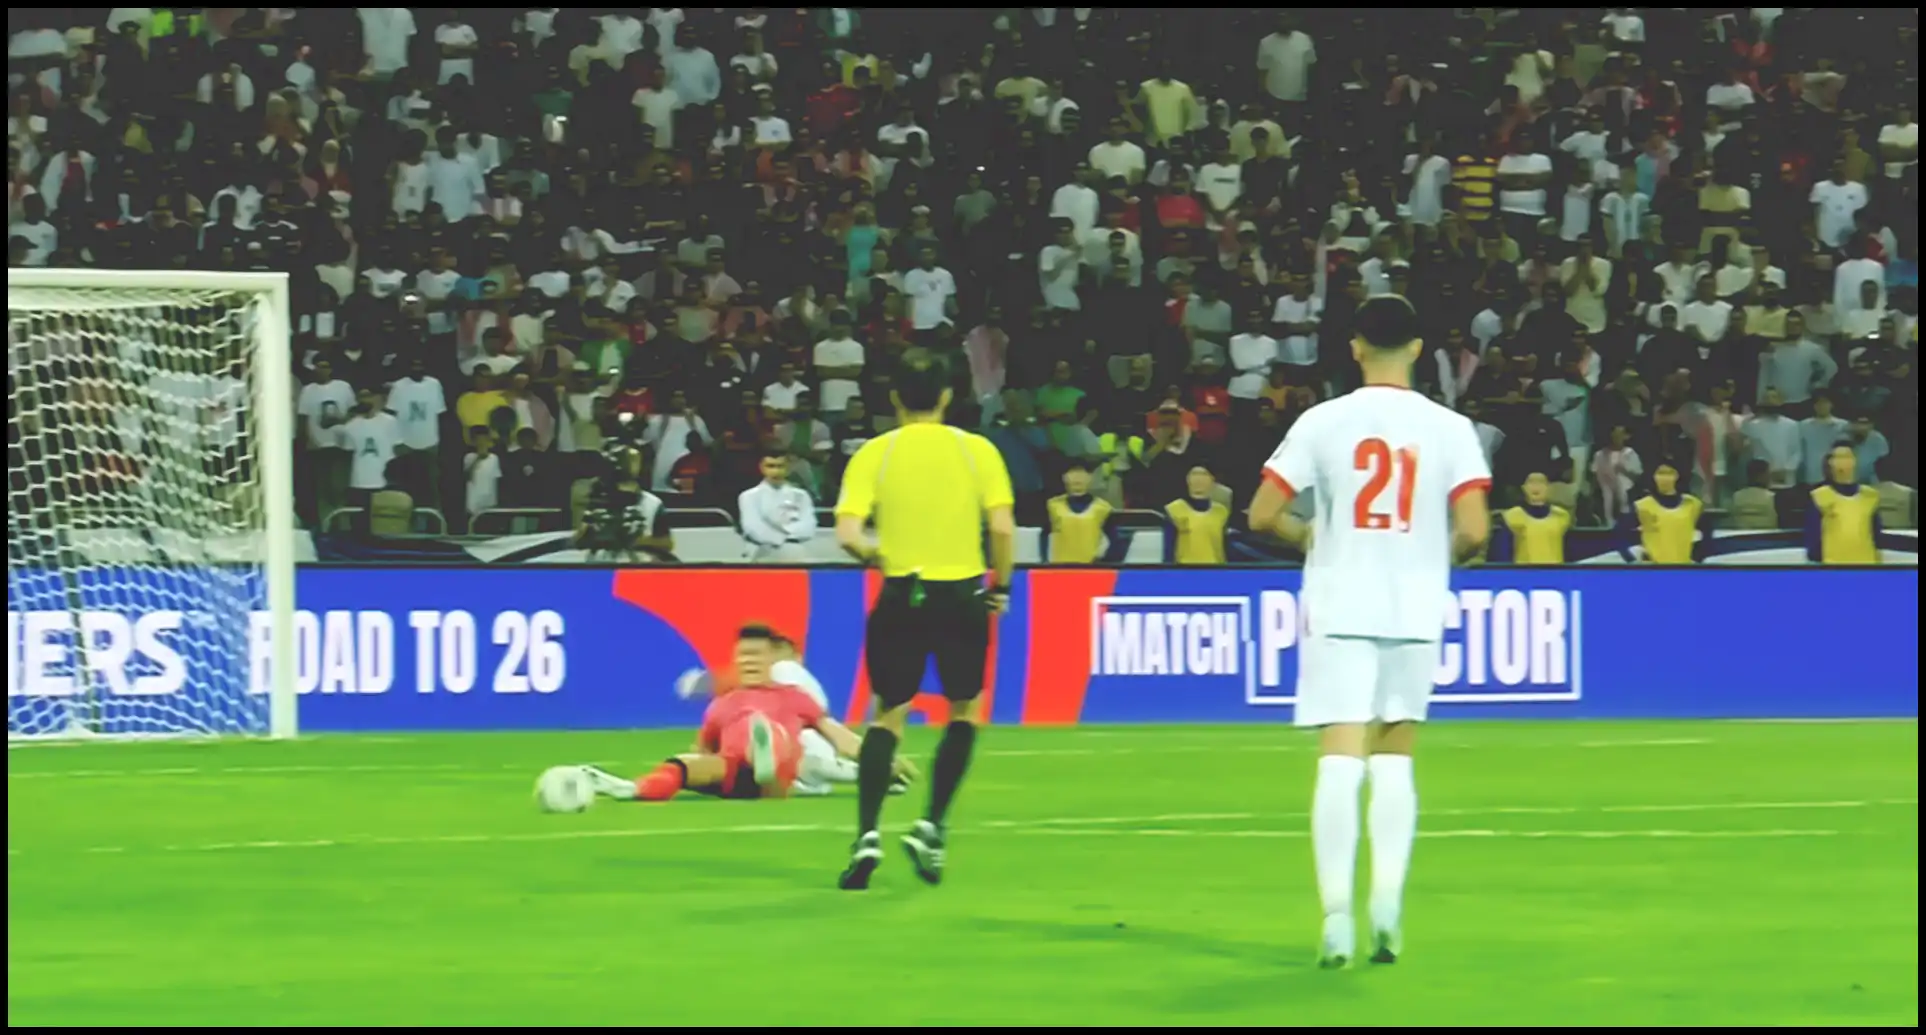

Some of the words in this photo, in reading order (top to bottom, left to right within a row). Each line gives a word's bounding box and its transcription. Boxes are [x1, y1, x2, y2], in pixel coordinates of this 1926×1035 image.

[360, 437, 379, 457] A
[1353, 437, 1418, 533] 21
[408, 610, 478, 694] TO
[492, 610, 567, 694] 26
[1102, 611, 1239, 675] MATCH
[1260, 588, 1567, 687] PCTOR
